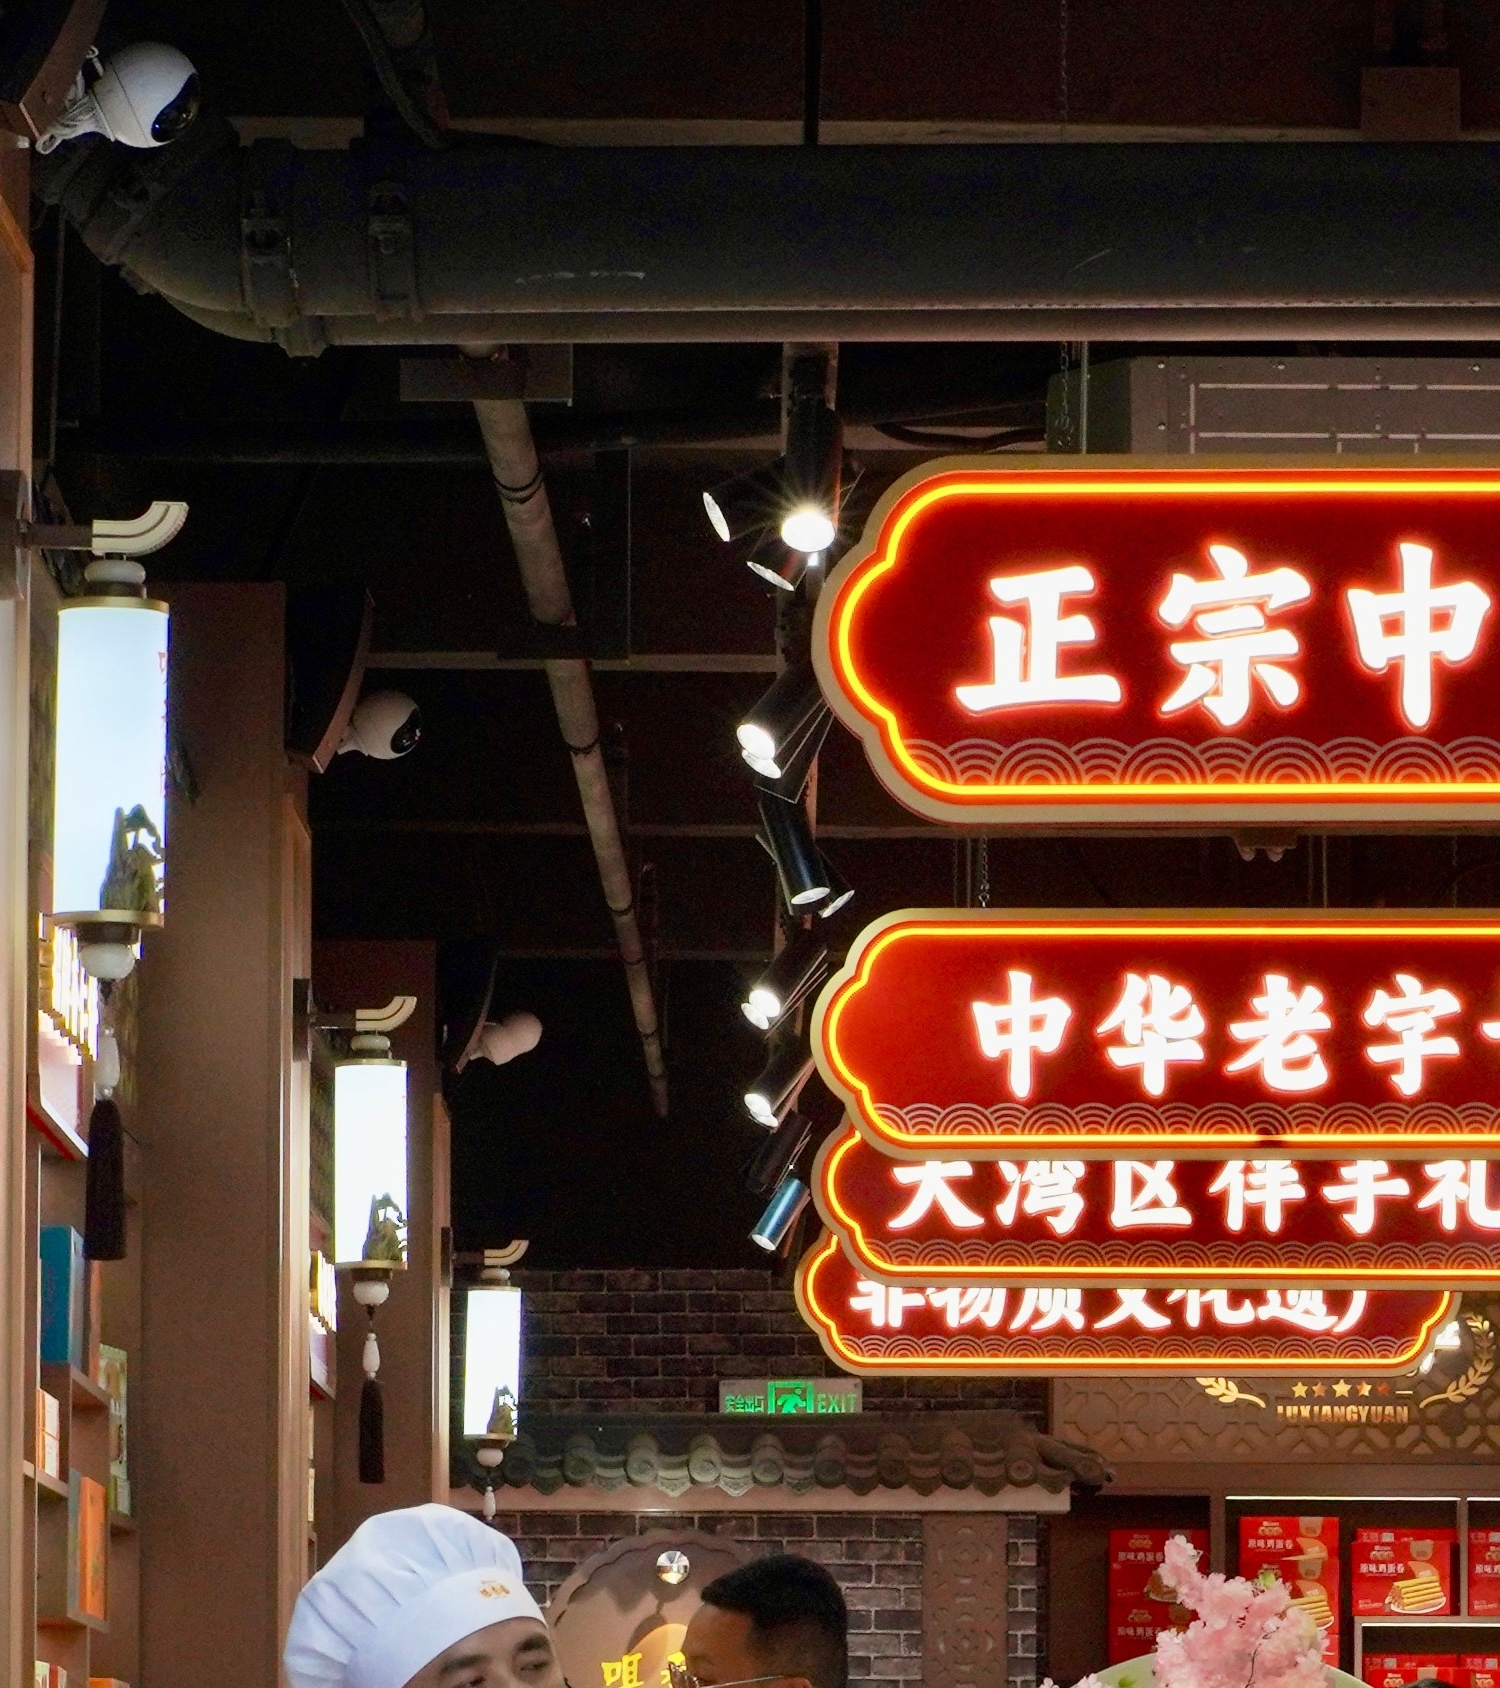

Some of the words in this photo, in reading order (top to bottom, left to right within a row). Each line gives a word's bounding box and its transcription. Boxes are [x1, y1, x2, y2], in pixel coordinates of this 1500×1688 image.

[725, 1395, 765, 1412] 安全出口
[817, 1394, 857, 1413] EXIT
[1359, 1563, 1405, 1574] 原味鸡蛋卷
